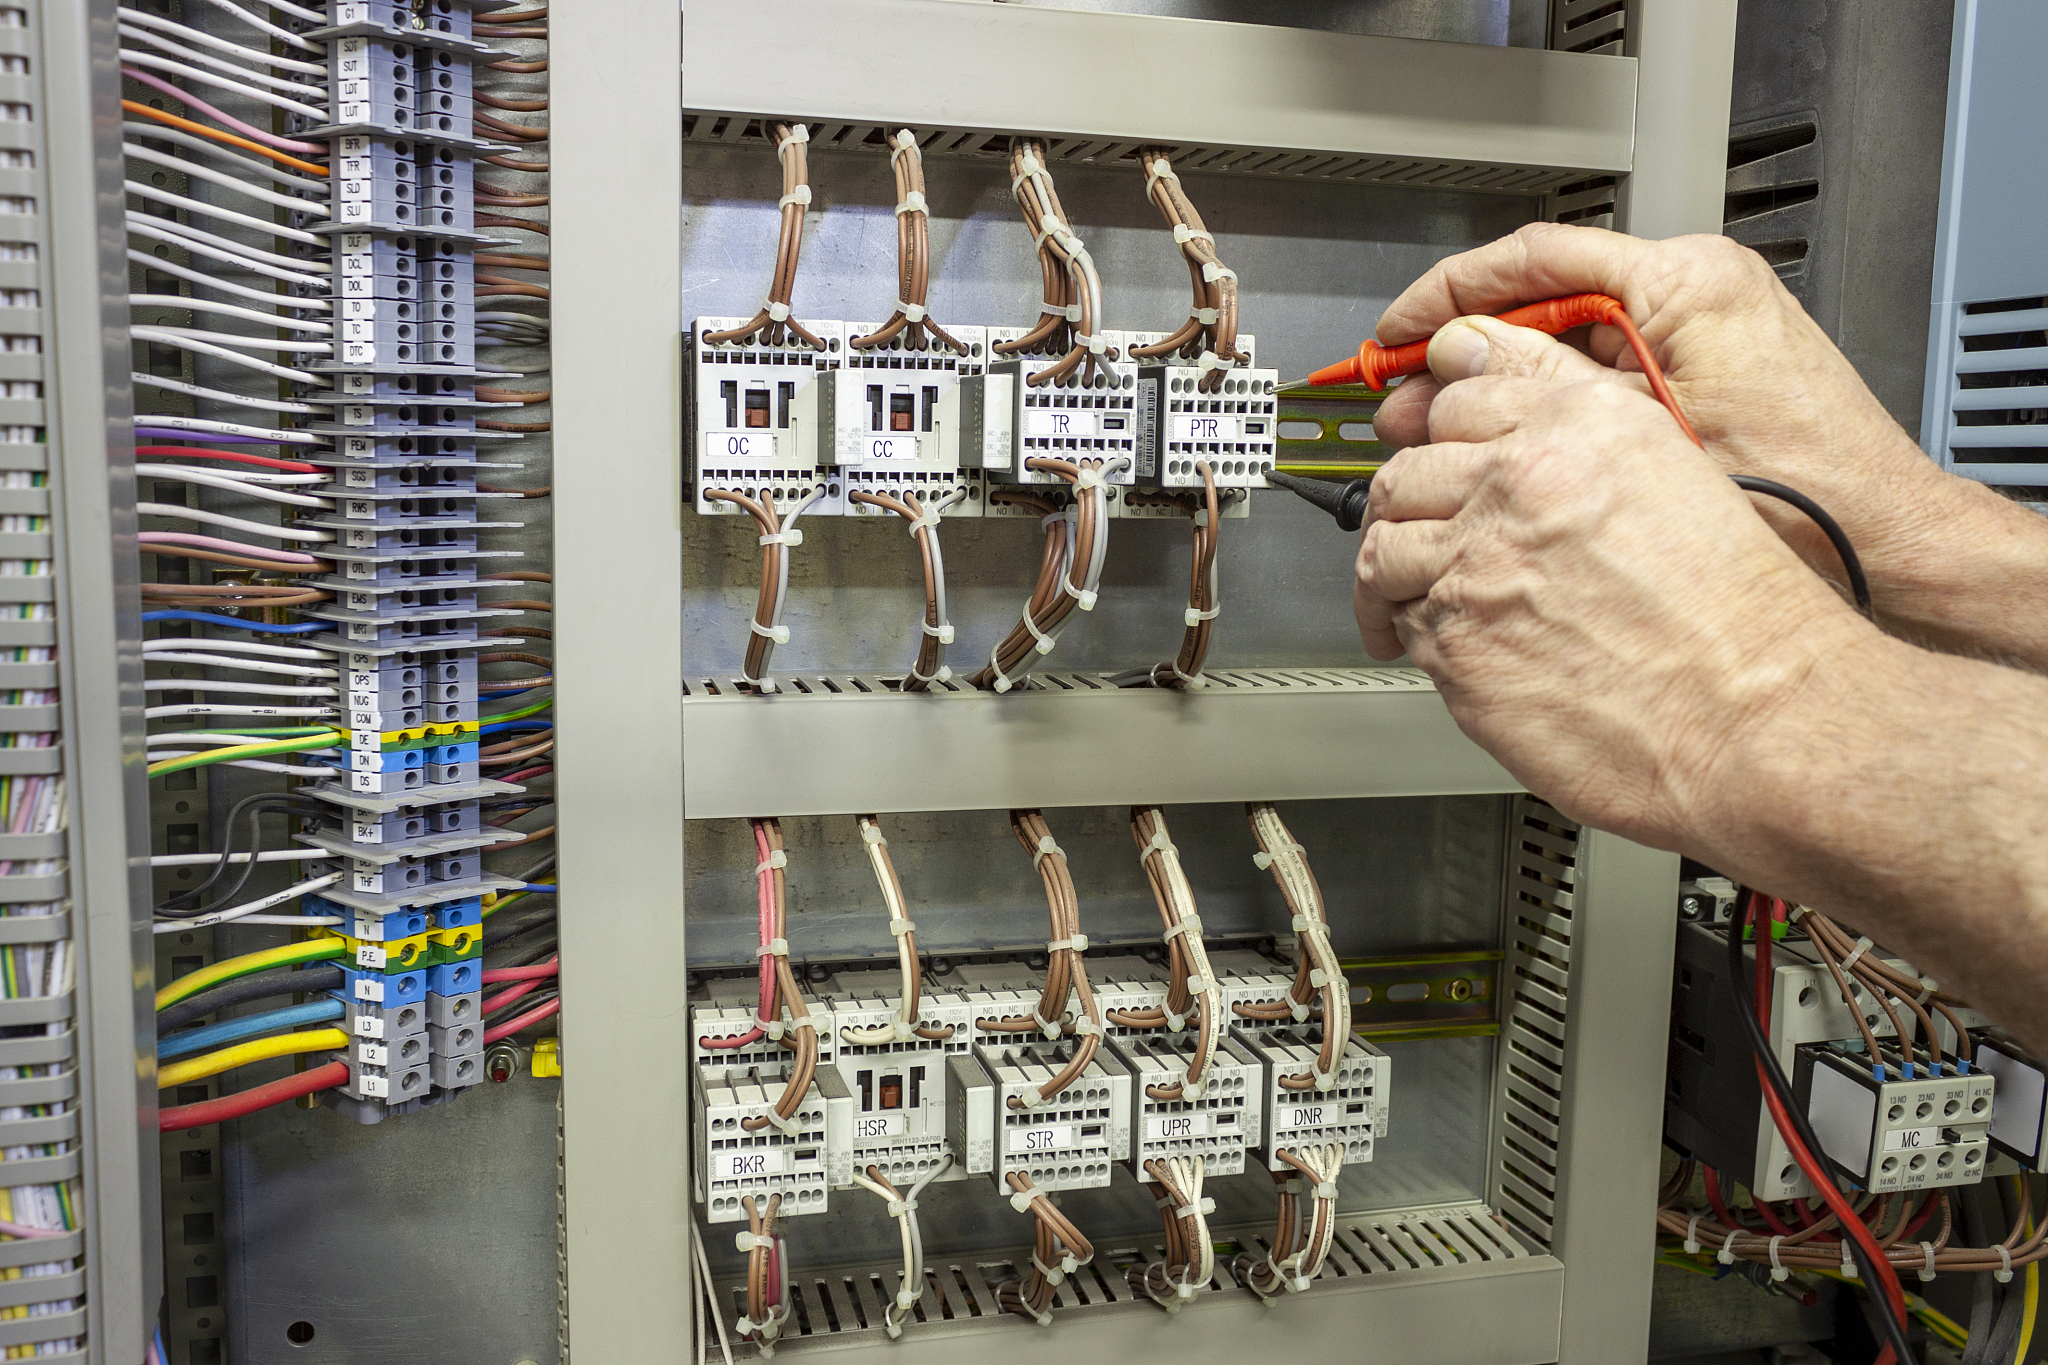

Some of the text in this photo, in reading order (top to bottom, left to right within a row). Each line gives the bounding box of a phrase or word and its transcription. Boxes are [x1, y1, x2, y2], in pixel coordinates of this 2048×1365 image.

[346, 9, 354, 18] G1
[344, 61, 357, 71] SUT
[345, 84, 357, 94] LDT
[346, 106, 358, 117] LUT
[346, 139, 360, 149] BFR
[347, 161, 359, 171] TFR
[347, 184, 360, 193] SLD
[347, 206, 360, 216] SLU
[348, 259, 362, 269] DCL
[349, 281, 362, 291] DOL
[352, 303, 360, 312] TO
[352, 325, 360, 333] TC
[857, 325, 868, 333] NO
[350, 346, 363, 355] DTC
[352, 378, 362, 387] NS
[353, 409, 361, 418] TS
[1051, 415, 1070, 433] TR
[1191, 419, 1218, 437] PTR
[728, 437, 749, 455] OC
[873, 441, 892, 457] CC
[352, 471, 366, 481] SGS
[354, 531, 363, 540] PS
[353, 563, 365, 573] OTL
[355, 676, 369, 685] OPS
[354, 696, 369, 705] NUG
[356, 714, 371, 723] COM
[360, 735, 369, 745] DE
[360, 756, 369, 765] DN
[360, 776, 369, 786] DS
[358, 827, 373, 837] BK+
[361, 877, 373, 886] THF
[364, 925, 369, 934] N
[365, 986, 370, 995] N
[1113, 998, 1123, 1006] NO
[1138, 997, 1148, 1005] NC
[983, 1007, 993, 1015] NO
[1008, 1006, 1018, 1014] NC
[874, 1014, 885, 1022] NC
[925, 1011, 936, 1019] NO
[848, 1016, 859, 1024] NO
[363, 1021, 371, 1031] L3
[708, 1025, 715, 1033] L1
[367, 1049, 375, 1059] L2
[368, 1082, 375, 1091] L1
[1094, 1080, 1104, 1088] NO
[1013, 1086, 1023, 1094] NO
[1974, 1088, 1991, 1097] 41 NC
[1890, 1096, 1897, 1104] 13
[1295, 1108, 1322, 1125] DNR
[858, 1121, 887, 1136] HSR
[1162, 1119, 1190, 1136] UPR
[1027, 1131, 1053, 1148] STR
[1901, 1132, 1920, 1147] MC
[1354, 1154, 1364, 1162] NO
[733, 1155, 765, 1174] BKR
[1972, 1168, 1980, 1176] NC
[899, 1175, 909, 1183] NC
[1888, 1177, 1896, 1185] NO
[1091, 1180, 1101, 1188] NO
